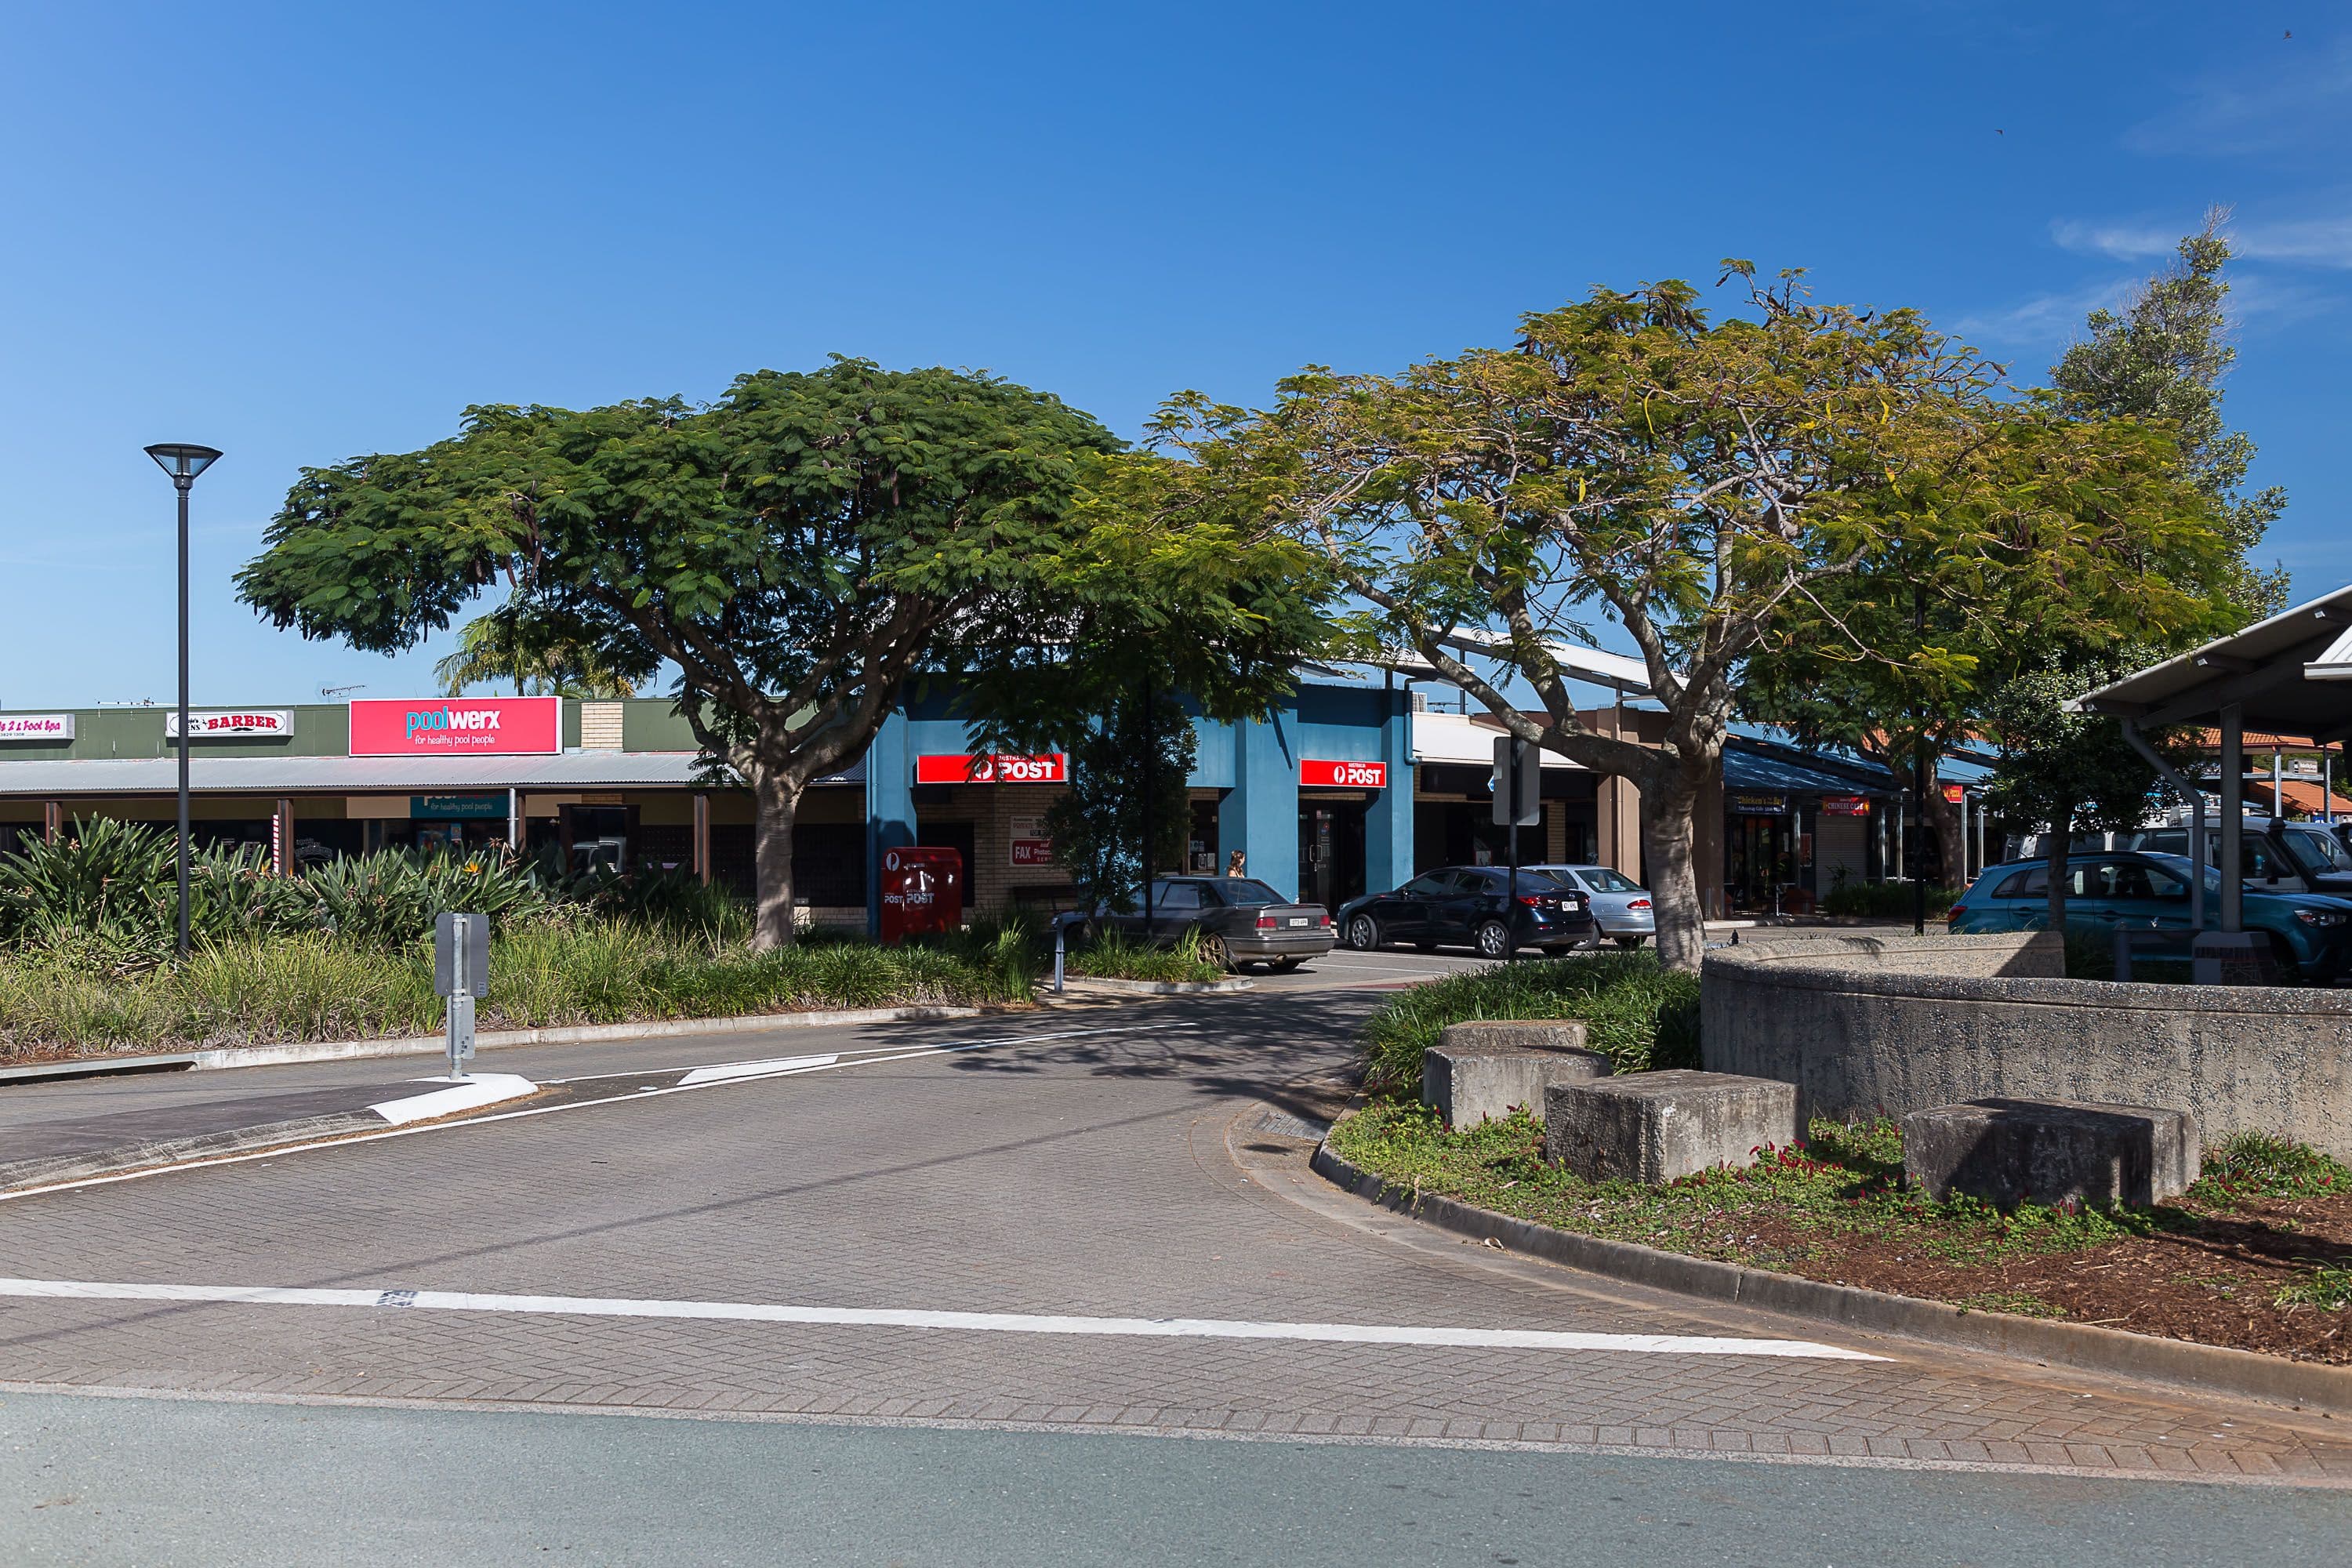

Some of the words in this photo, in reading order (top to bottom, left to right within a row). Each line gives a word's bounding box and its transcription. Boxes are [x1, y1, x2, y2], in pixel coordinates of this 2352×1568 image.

[24, 720, 42, 731] Foot
[45, 720, 60, 732] Spa
[208, 715, 277, 730] BARBER
[406, 706, 501, 739] poolwerx
[415, 735, 426, 745] for
[427, 734, 452, 746] healthy
[455, 734, 470, 746] pool
[472, 733, 495, 746] people
[998, 761, 1056, 779] POST
[1348, 768, 1381, 784] POST
[441, 803, 460, 811] healthy
[461, 803, 474, 812] pool
[1015, 847, 1031, 859] FAX
[907, 892, 935, 904] POST
